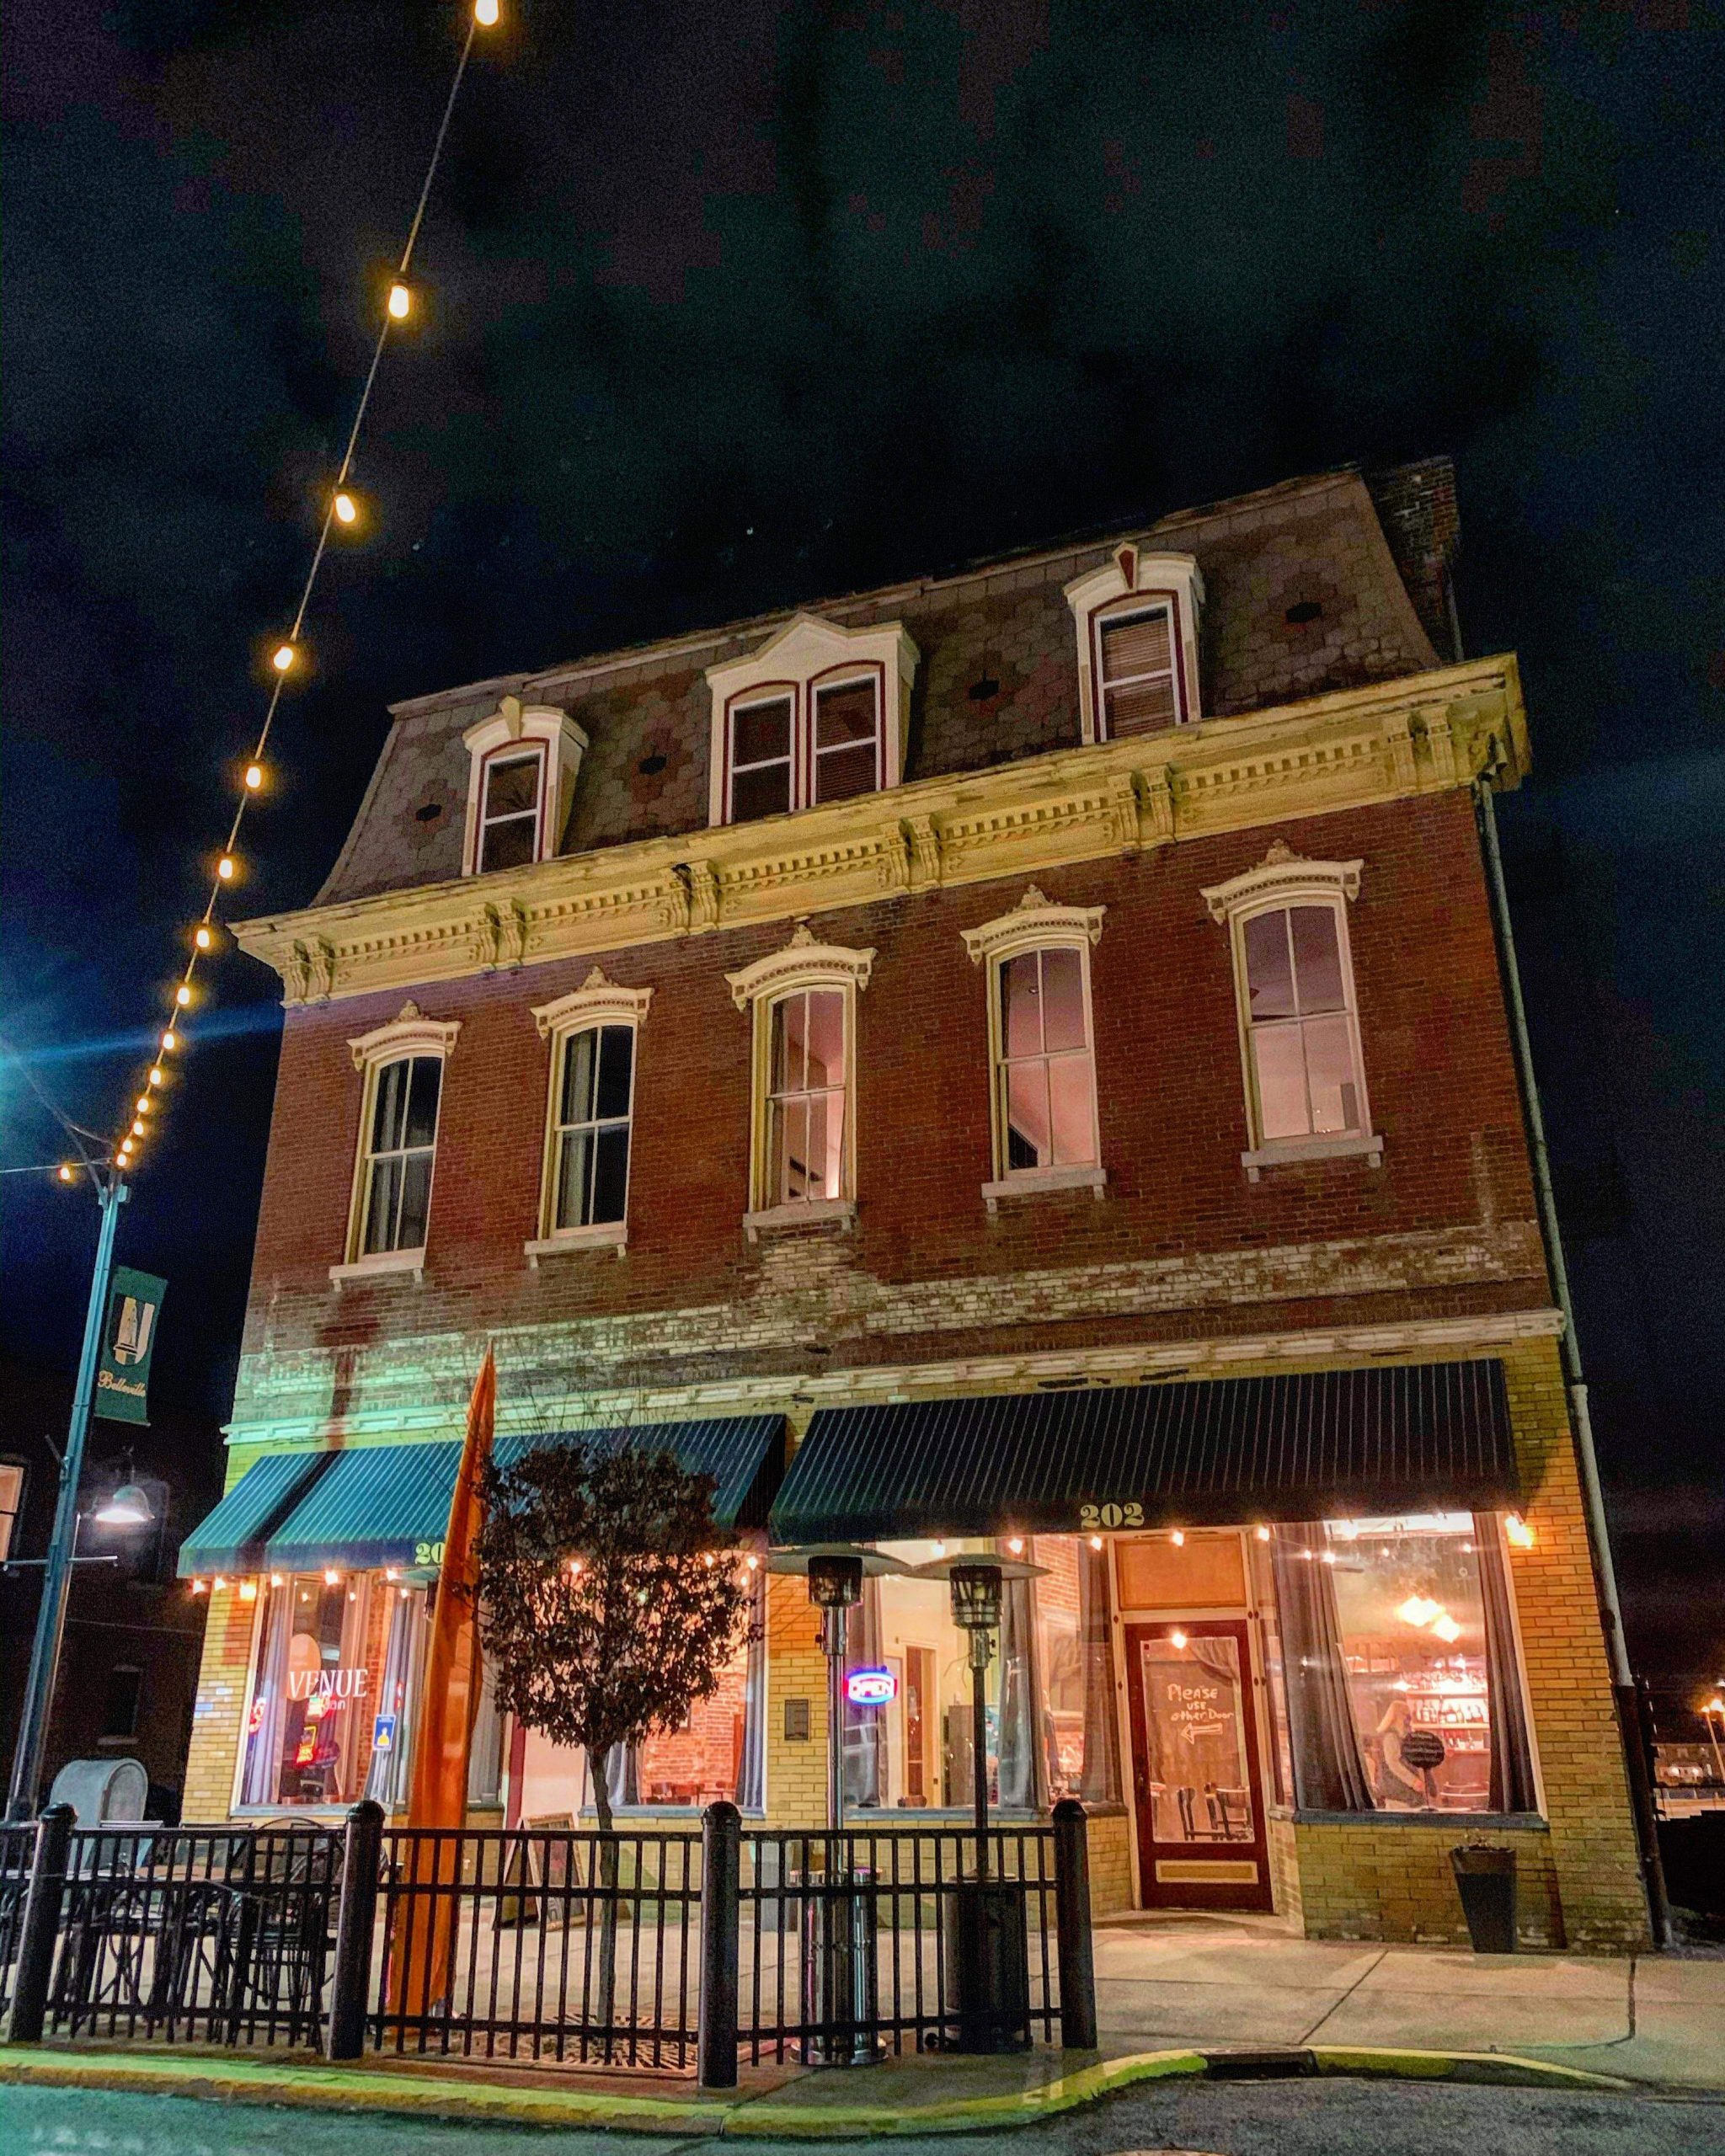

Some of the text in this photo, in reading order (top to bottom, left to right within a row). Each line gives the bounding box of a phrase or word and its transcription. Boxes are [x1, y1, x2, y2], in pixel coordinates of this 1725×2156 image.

[98, 1369, 146, 1397] Belleville
[1080, 1502, 1145, 1530] 202
[414, 1542, 446, 1565] 20
[289, 1668, 368, 1699] VENUE
[849, 1678, 893, 1697] OPEN
